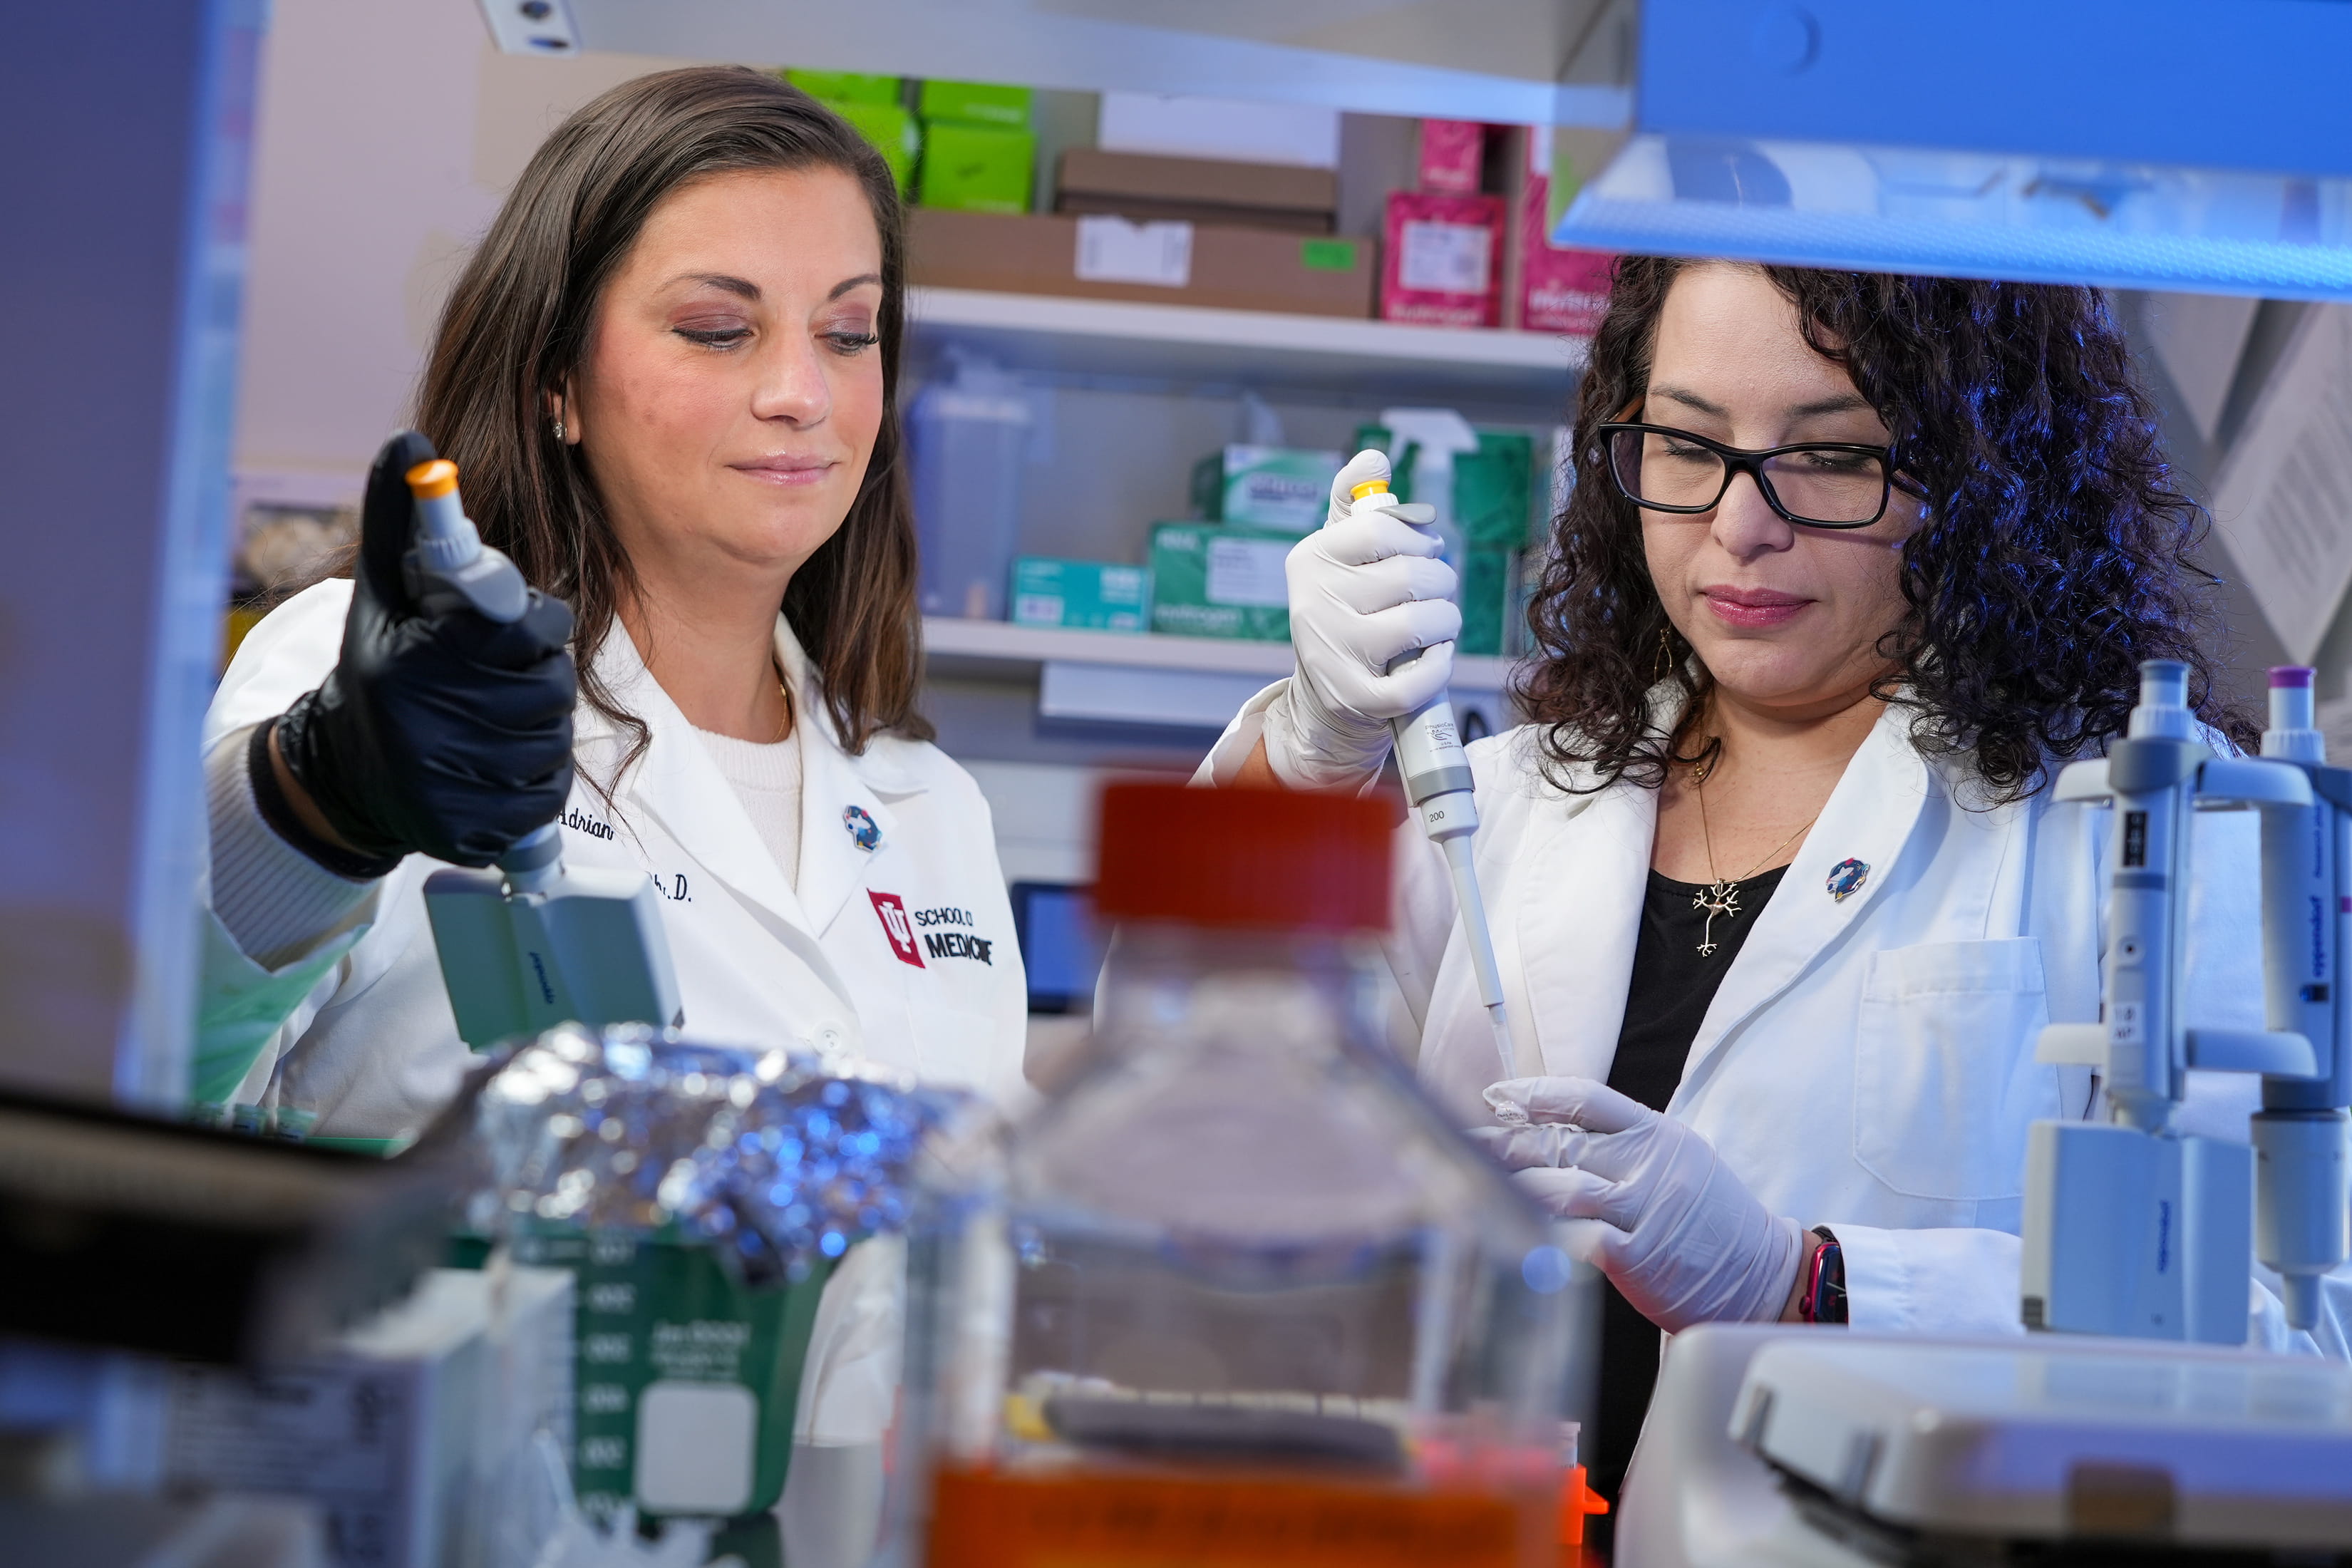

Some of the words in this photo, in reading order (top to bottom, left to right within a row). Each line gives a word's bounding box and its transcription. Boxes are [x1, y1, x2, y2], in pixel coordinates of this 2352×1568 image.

[557, 807, 614, 841] Adrian
[1429, 810, 1445, 822] 200
[645, 870, 691, 902] h.D.
[915, 907, 966, 927] SCHOO
